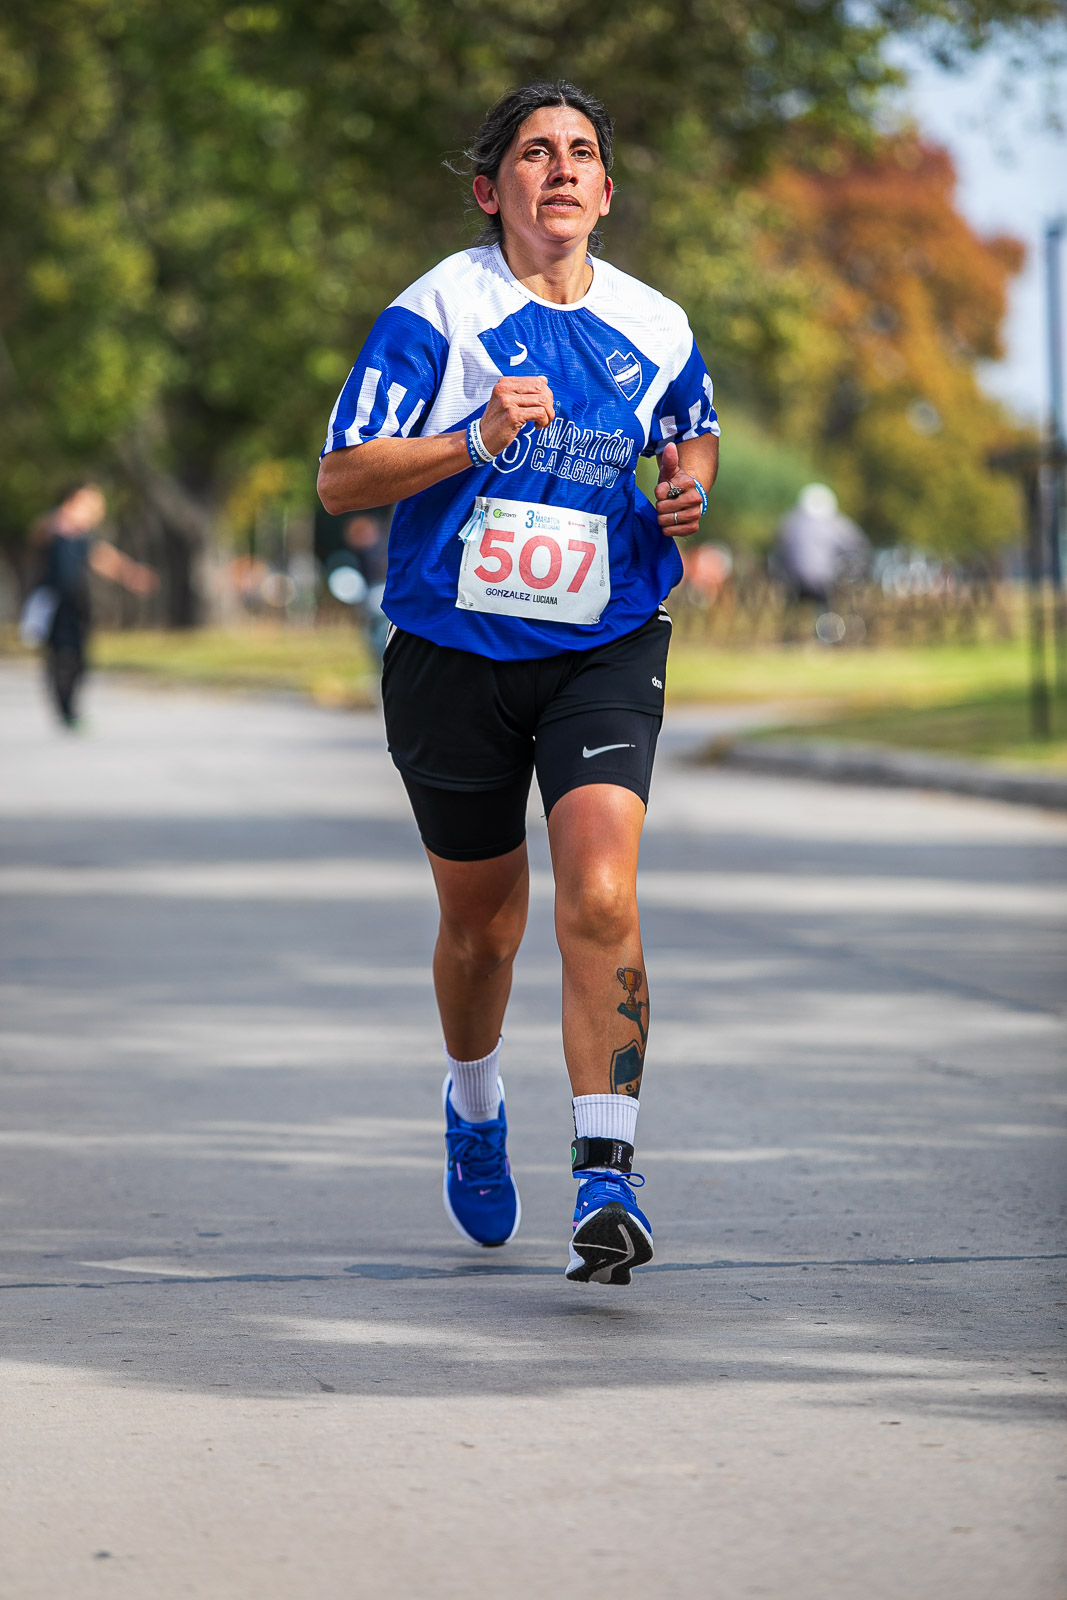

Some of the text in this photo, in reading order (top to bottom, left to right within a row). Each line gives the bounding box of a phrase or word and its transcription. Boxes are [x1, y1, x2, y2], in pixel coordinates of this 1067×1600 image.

[525, 509, 535, 529] 3
[474, 528, 597, 594] 507
[485, 587, 558, 605] GONZALEZ LUCIANA
